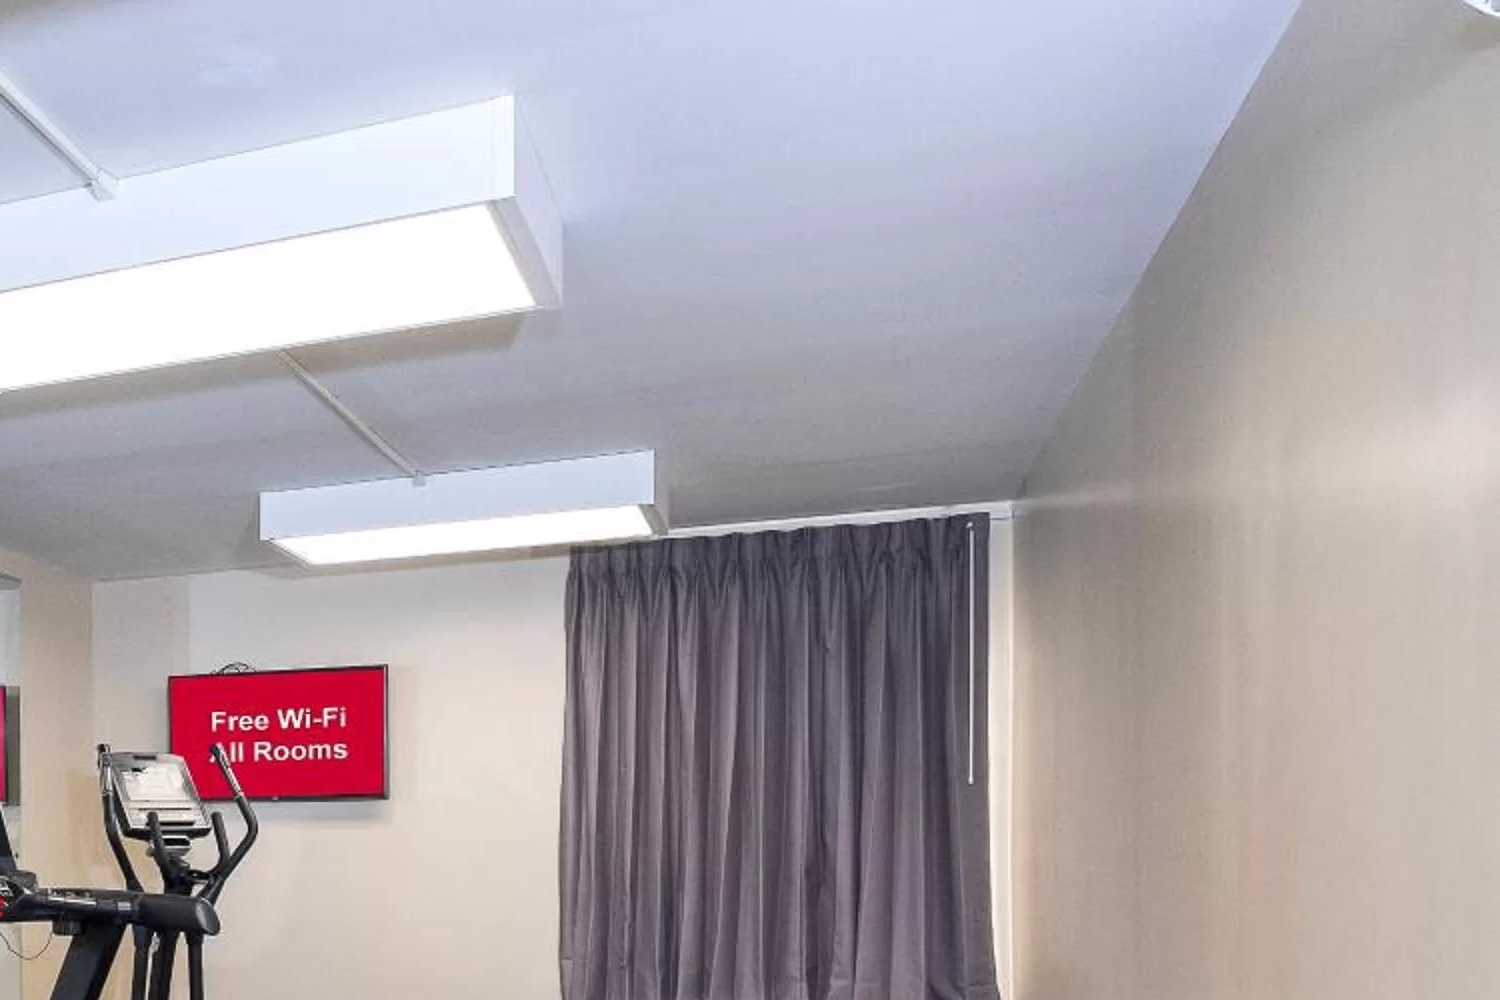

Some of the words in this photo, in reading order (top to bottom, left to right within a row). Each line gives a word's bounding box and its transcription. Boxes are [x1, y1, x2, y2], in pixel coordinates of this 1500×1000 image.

[211, 711, 269, 732] Free
[277, 706, 347, 729] Wi-Fi
[253, 741, 348, 762] Rooms
